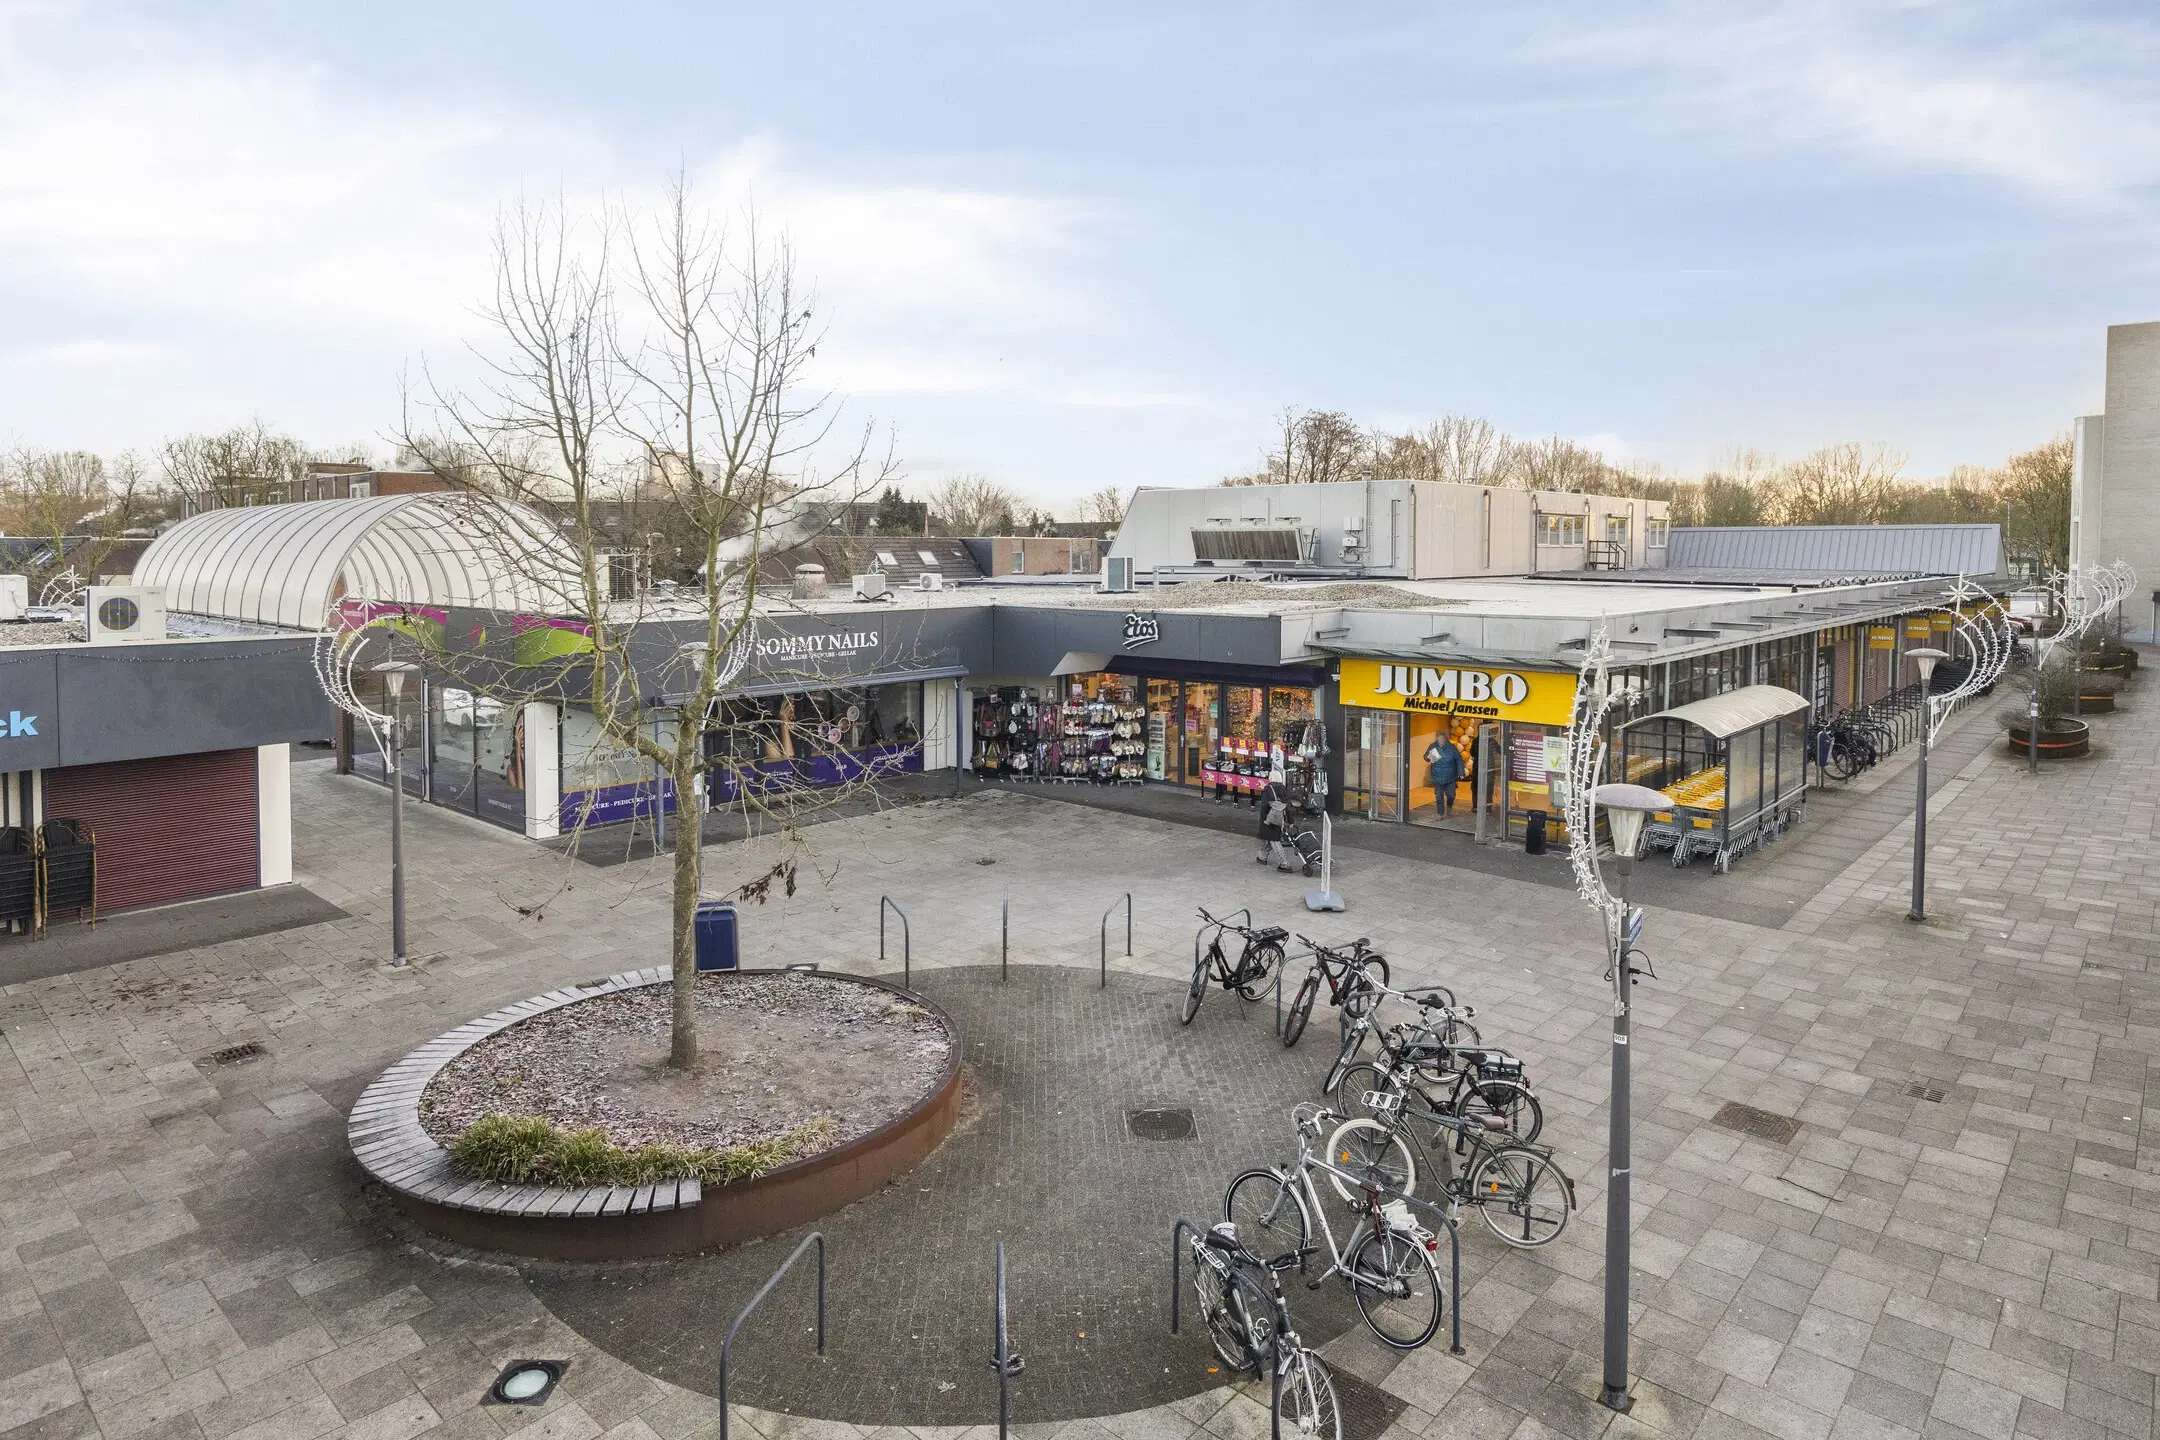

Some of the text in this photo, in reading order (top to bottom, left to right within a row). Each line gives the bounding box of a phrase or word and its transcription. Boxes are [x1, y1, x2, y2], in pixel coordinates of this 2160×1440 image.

[1122, 613, 1158, 641] Etos
[756, 631, 878, 656] SOMMY NAILS
[1374, 665, 1528, 705] JUMBO
[1403, 698, 1498, 717] Michael Janssen
